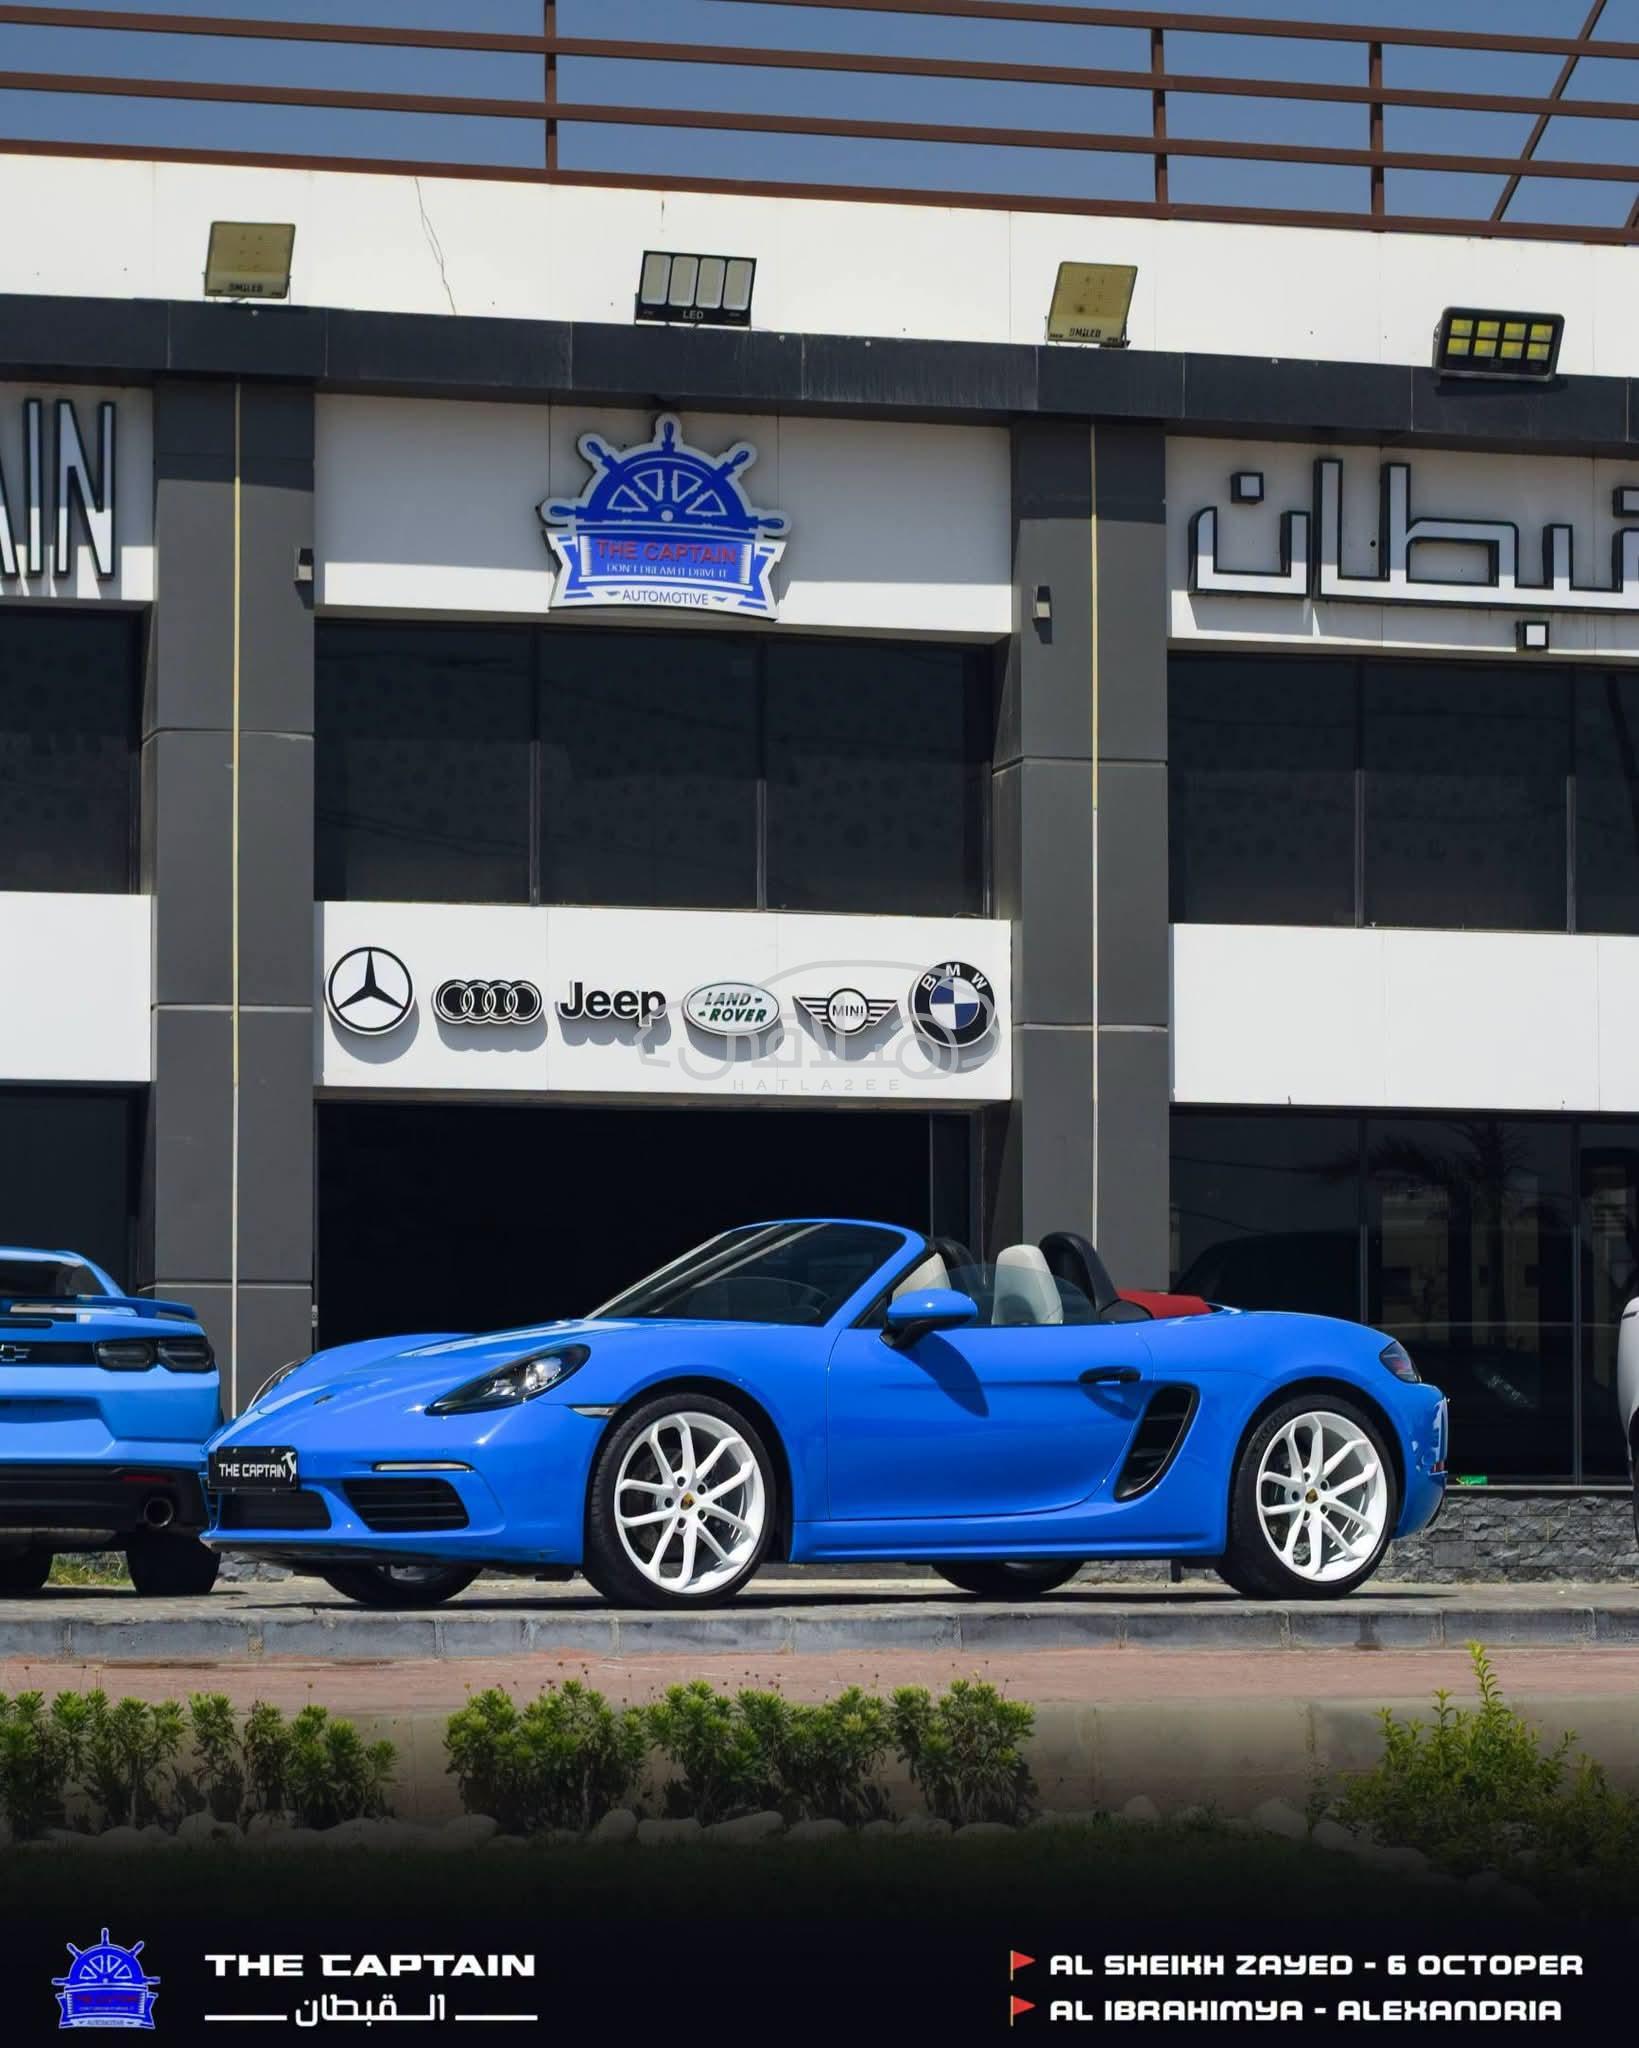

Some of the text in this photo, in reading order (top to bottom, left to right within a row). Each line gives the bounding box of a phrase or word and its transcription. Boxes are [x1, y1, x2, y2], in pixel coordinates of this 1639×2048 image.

[683, 310, 704, 320] LED
[0, 398, 115, 579] IN
[596, 539, 737, 565] THE CAPTAIN
[622, 588, 709, 606] AUTOMOTIVE
[921, 963, 989, 991] BMW
[557, 980, 667, 1028] Jeep
[704, 991, 752, 1006] LAND
[708, 1007, 768, 1023] ROVER
[832, 1004, 864, 1018] MINI
[218, 1463, 287, 1479] THE CAPTAIN
